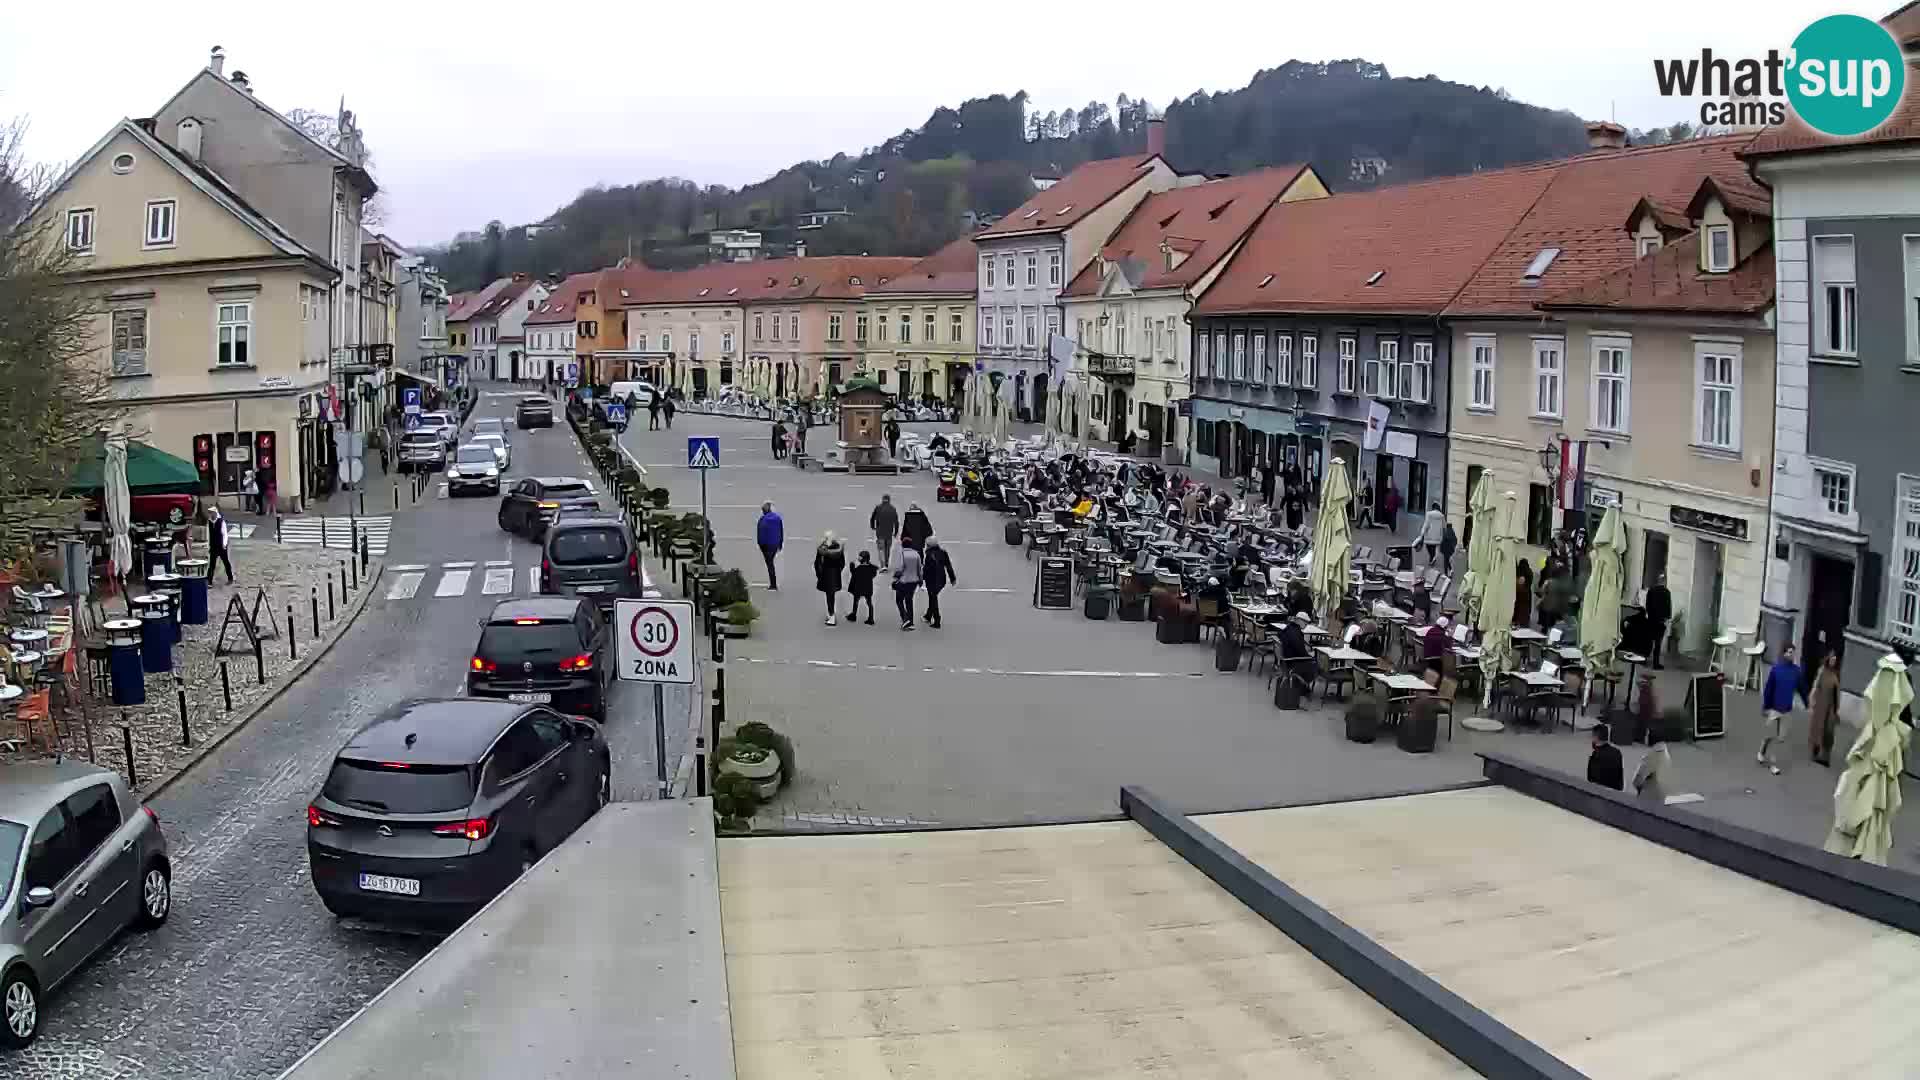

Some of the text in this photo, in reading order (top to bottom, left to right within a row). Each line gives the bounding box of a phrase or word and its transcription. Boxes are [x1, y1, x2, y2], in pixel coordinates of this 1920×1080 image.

[408, 391, 416, 403] P
[643, 622, 667, 643] 30
[633, 660, 678, 676] ZONA
